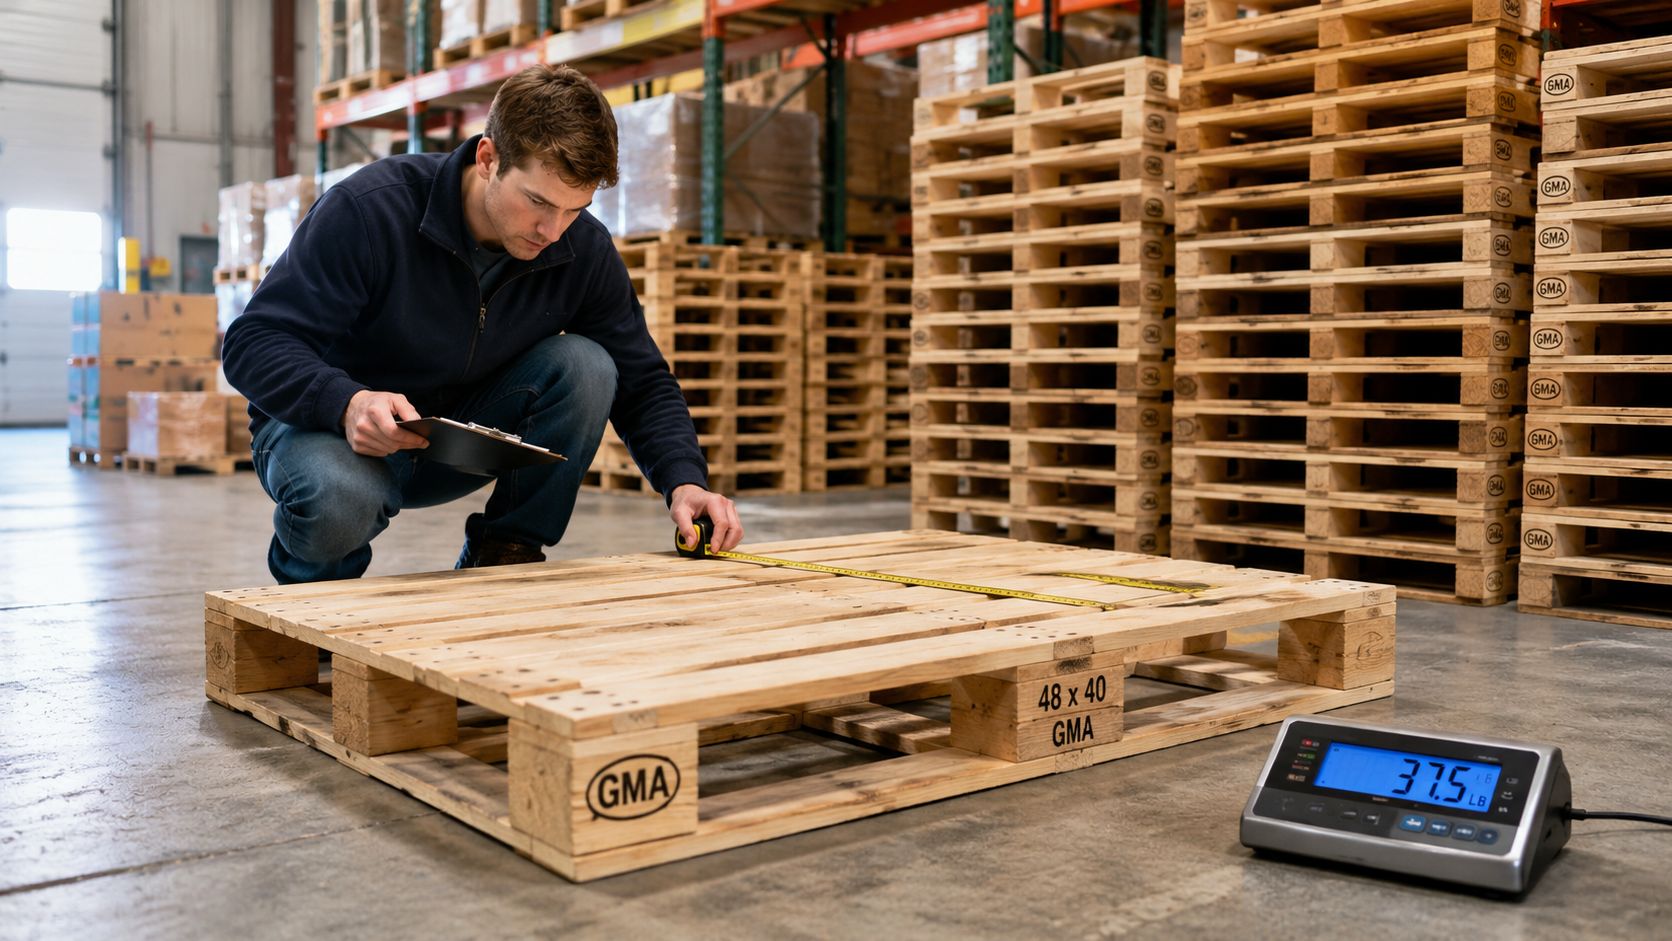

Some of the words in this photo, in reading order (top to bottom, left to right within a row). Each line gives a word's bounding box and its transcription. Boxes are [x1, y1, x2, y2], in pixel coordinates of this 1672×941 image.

[1548, 78, 1570, 92] GMA
[1544, 180, 1567, 193] GMA
[1541, 232, 1565, 244] GMA
[1539, 282, 1563, 295] GMA
[1536, 333, 1559, 345] GMA
[1534, 383, 1557, 395] GMA
[1531, 433, 1554, 446] GMA
[1529, 483, 1551, 496] GMA
[1527, 533, 1549, 546] GMA
[1038, 683, 1062, 712] 48
[1068, 687, 1078, 707] x
[1084, 675, 1106, 703] 40
[1052, 715, 1094, 747] GMA
[597, 765, 670, 809] GMA
[1392, 758, 1471, 802] 37.5
[1468, 794, 1487, 807] LB
